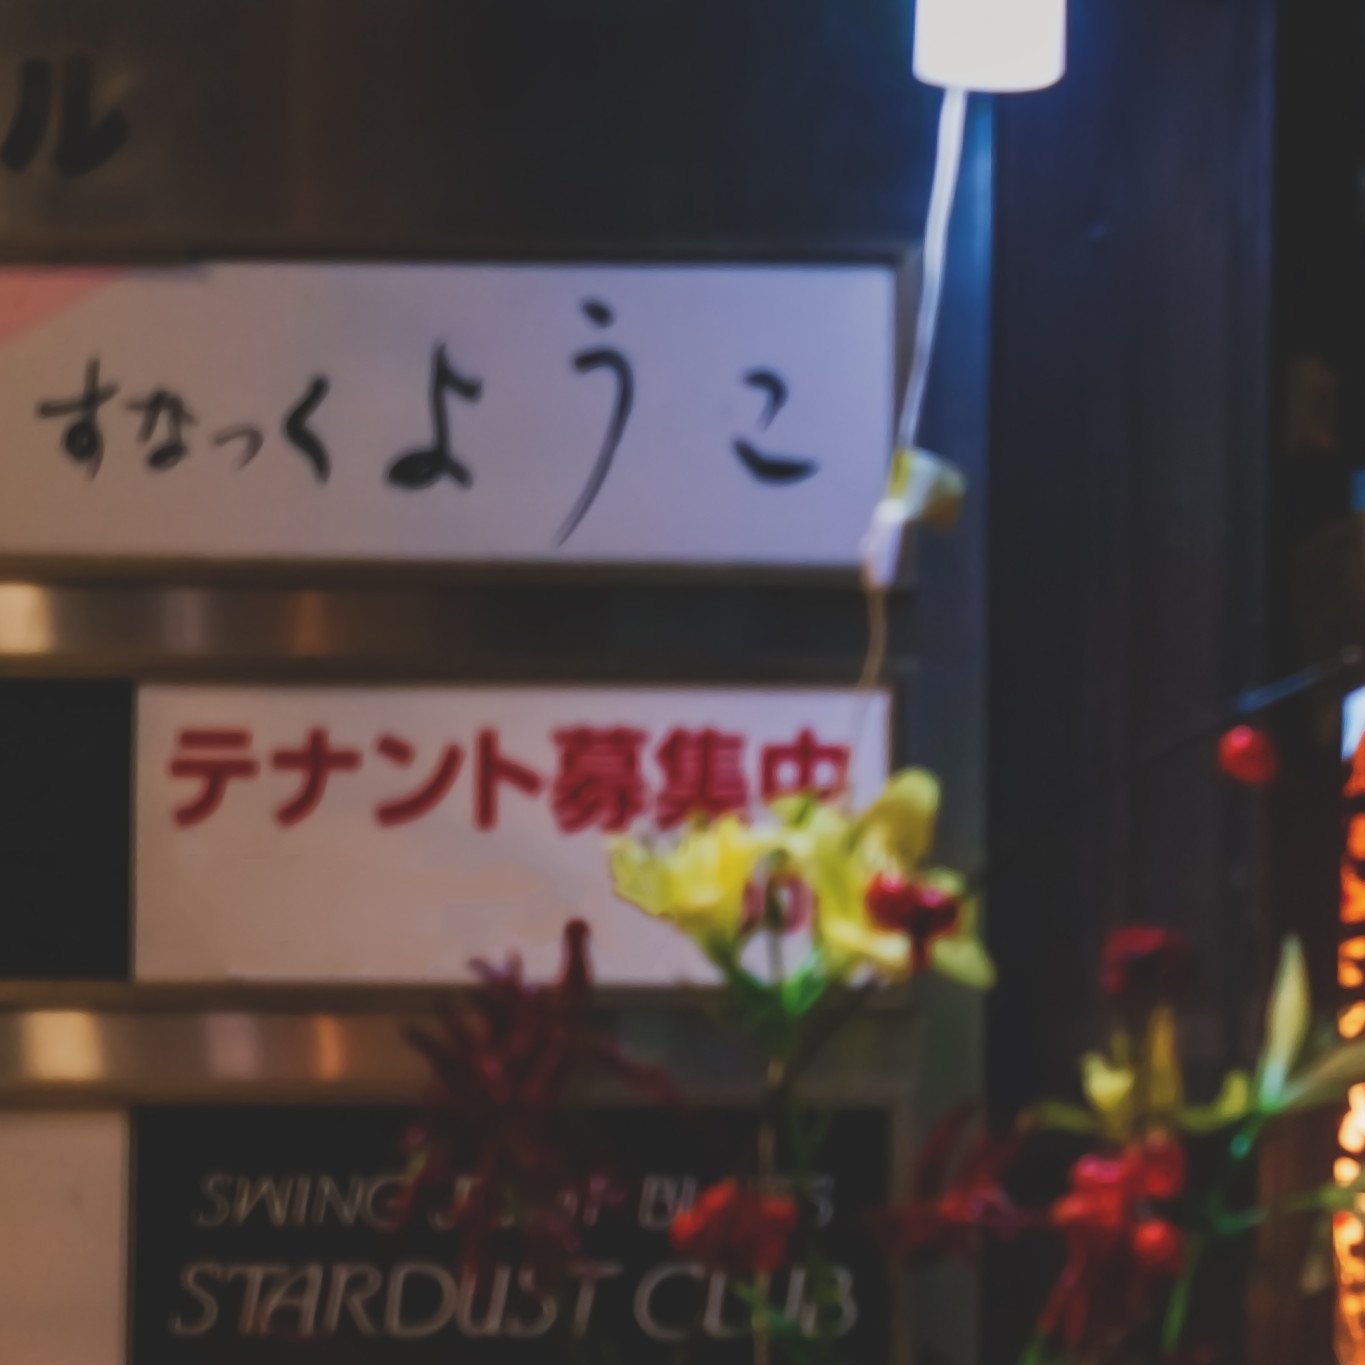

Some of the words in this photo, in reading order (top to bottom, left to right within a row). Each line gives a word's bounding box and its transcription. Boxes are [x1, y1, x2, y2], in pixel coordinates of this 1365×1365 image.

[168, 726, 852, 832] テナント募集中
[166, 1258, 623, 1341] STARDUST
